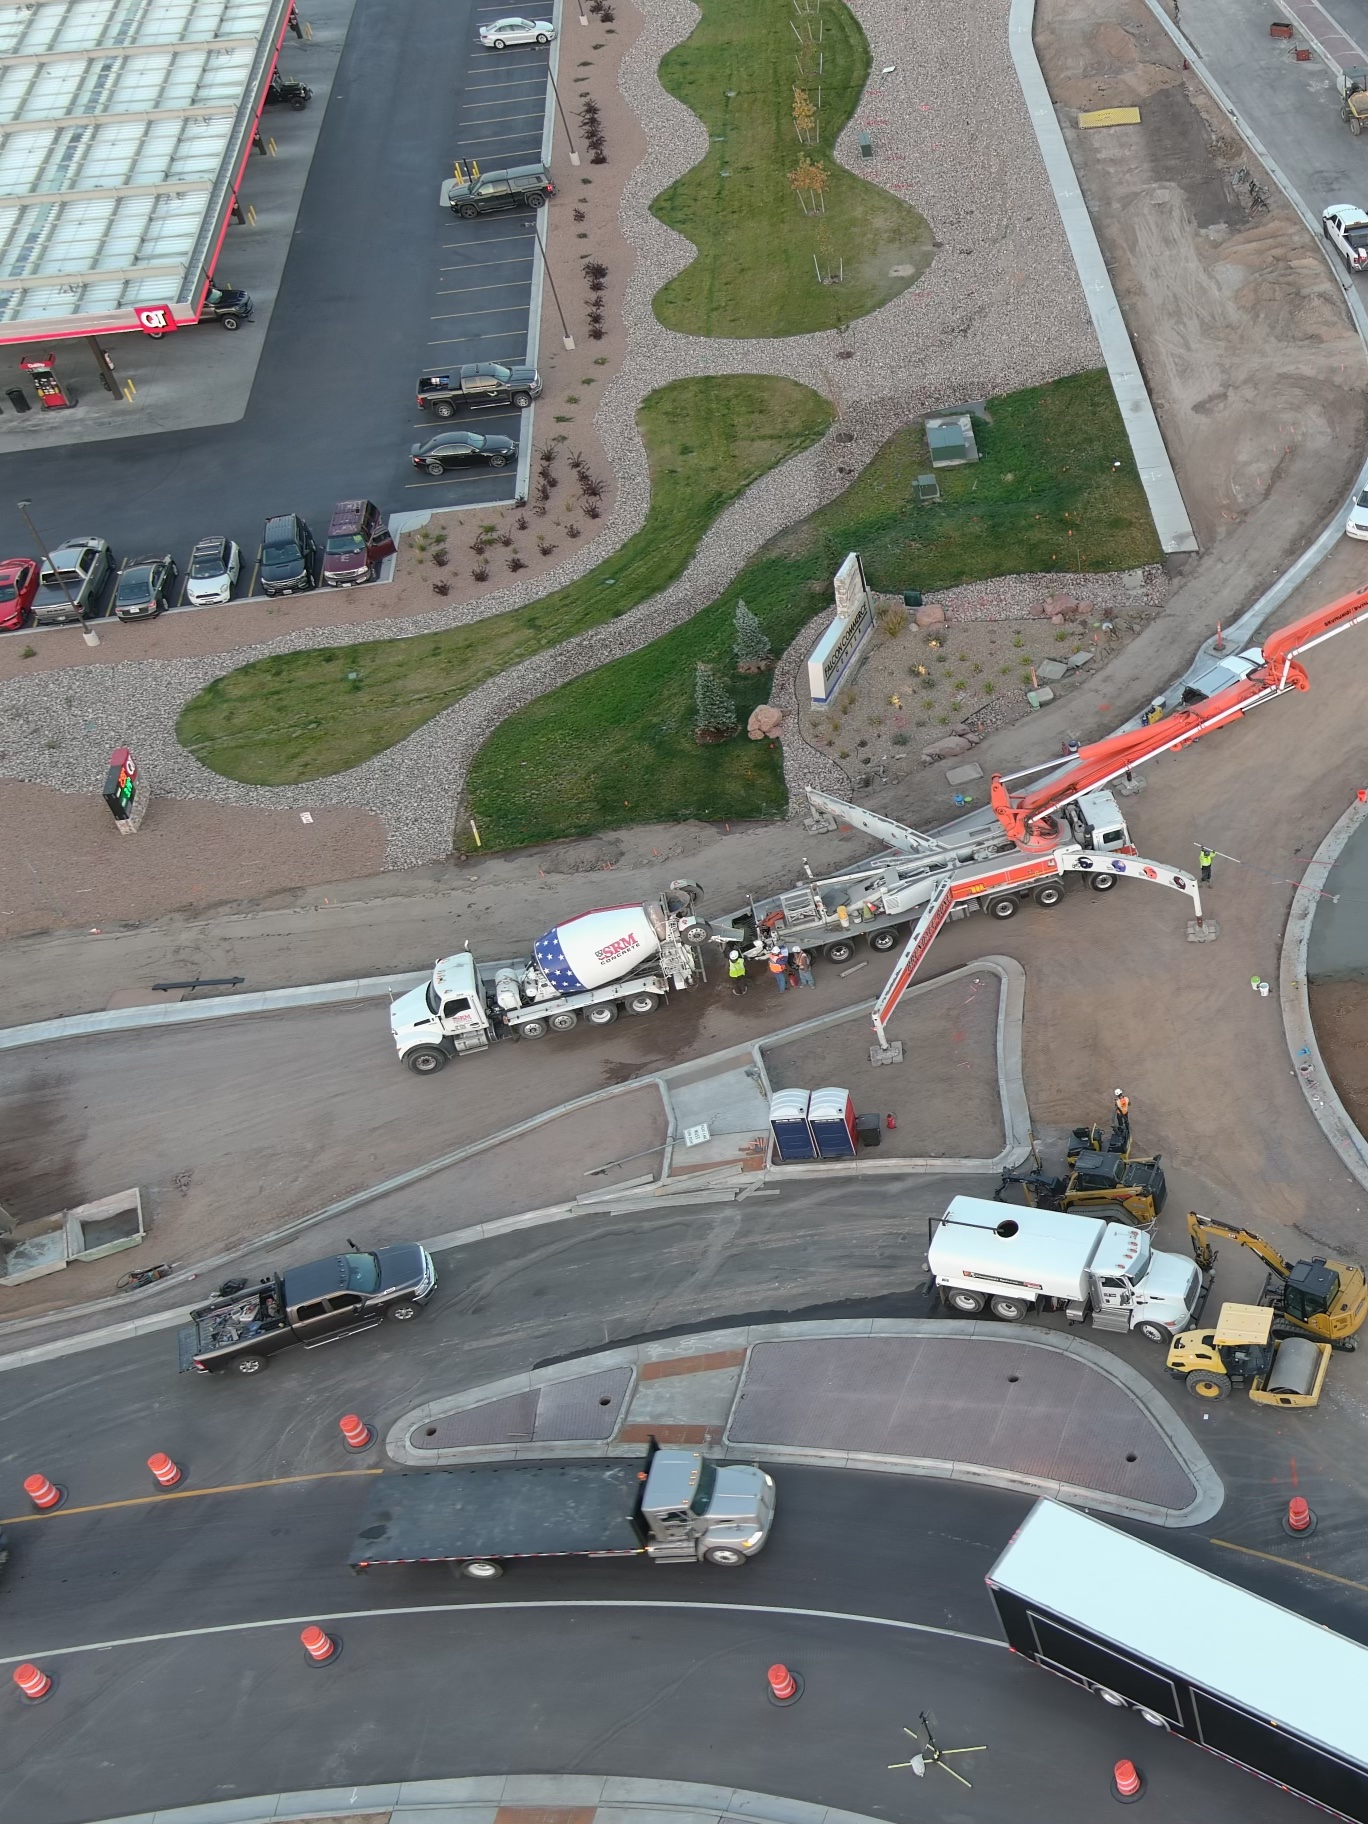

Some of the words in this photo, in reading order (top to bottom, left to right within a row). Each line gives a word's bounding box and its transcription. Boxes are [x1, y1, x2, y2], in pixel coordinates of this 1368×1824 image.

[141, 310, 168, 328] QT
[824, 642, 843, 677] FALCON
[841, 602, 867, 647] COMMERCE
[600, 942, 641, 966] CONCRETE
[602, 932, 639, 959] SRM
